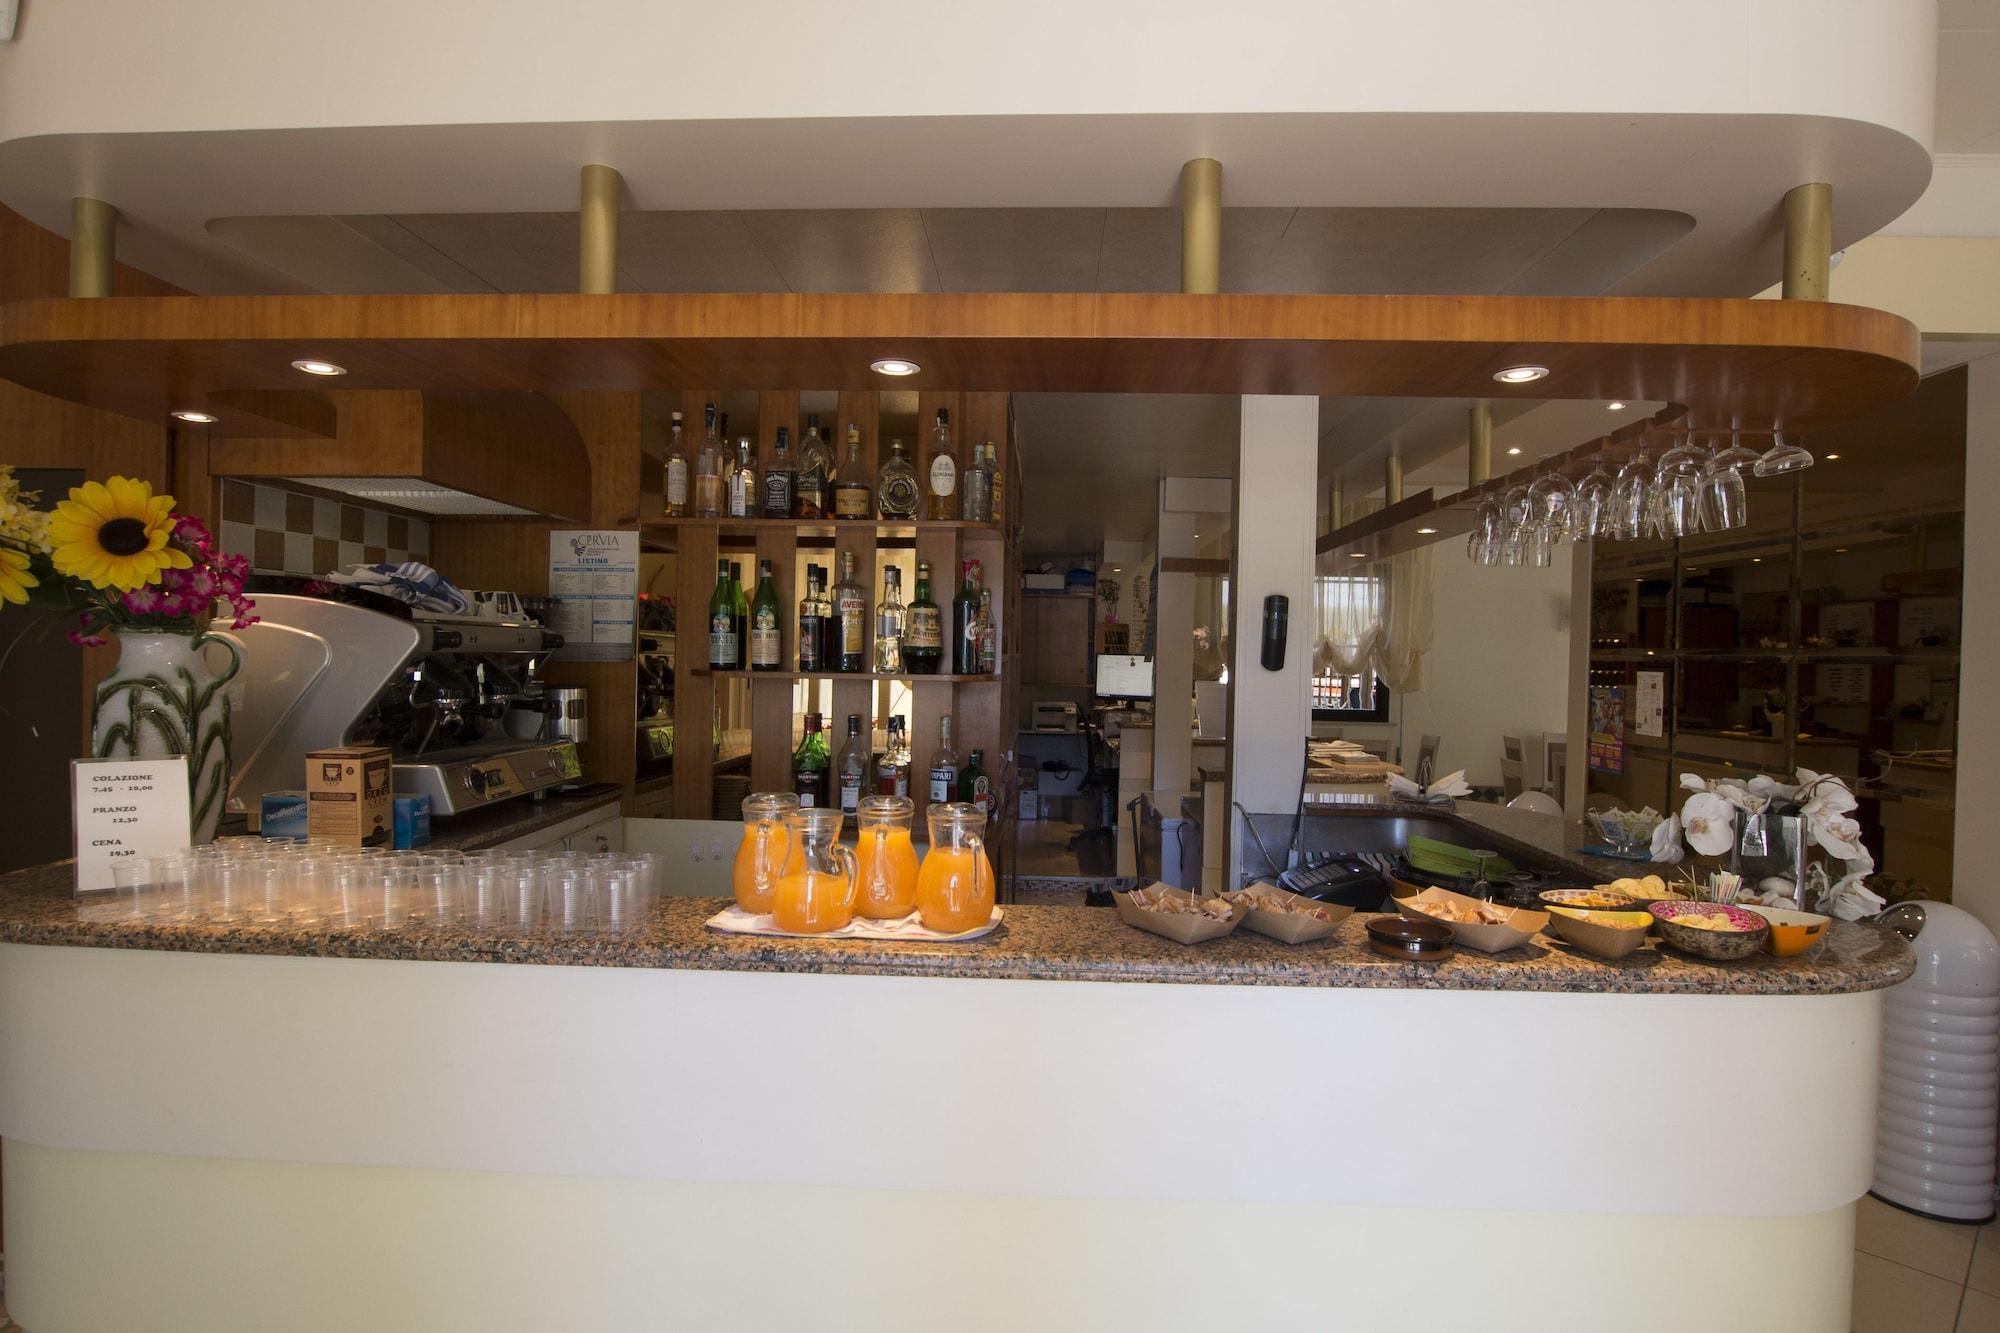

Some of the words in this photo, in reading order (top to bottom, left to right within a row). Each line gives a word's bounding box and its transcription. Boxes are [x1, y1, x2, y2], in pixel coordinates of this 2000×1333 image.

[577, 533, 620, 546] CERVIA
[841, 600, 865, 609] AVERN
[92, 774, 153, 782] COLAZIONE
[92, 806, 137, 814] PRANZO
[91, 839, 122, 847] CENA
